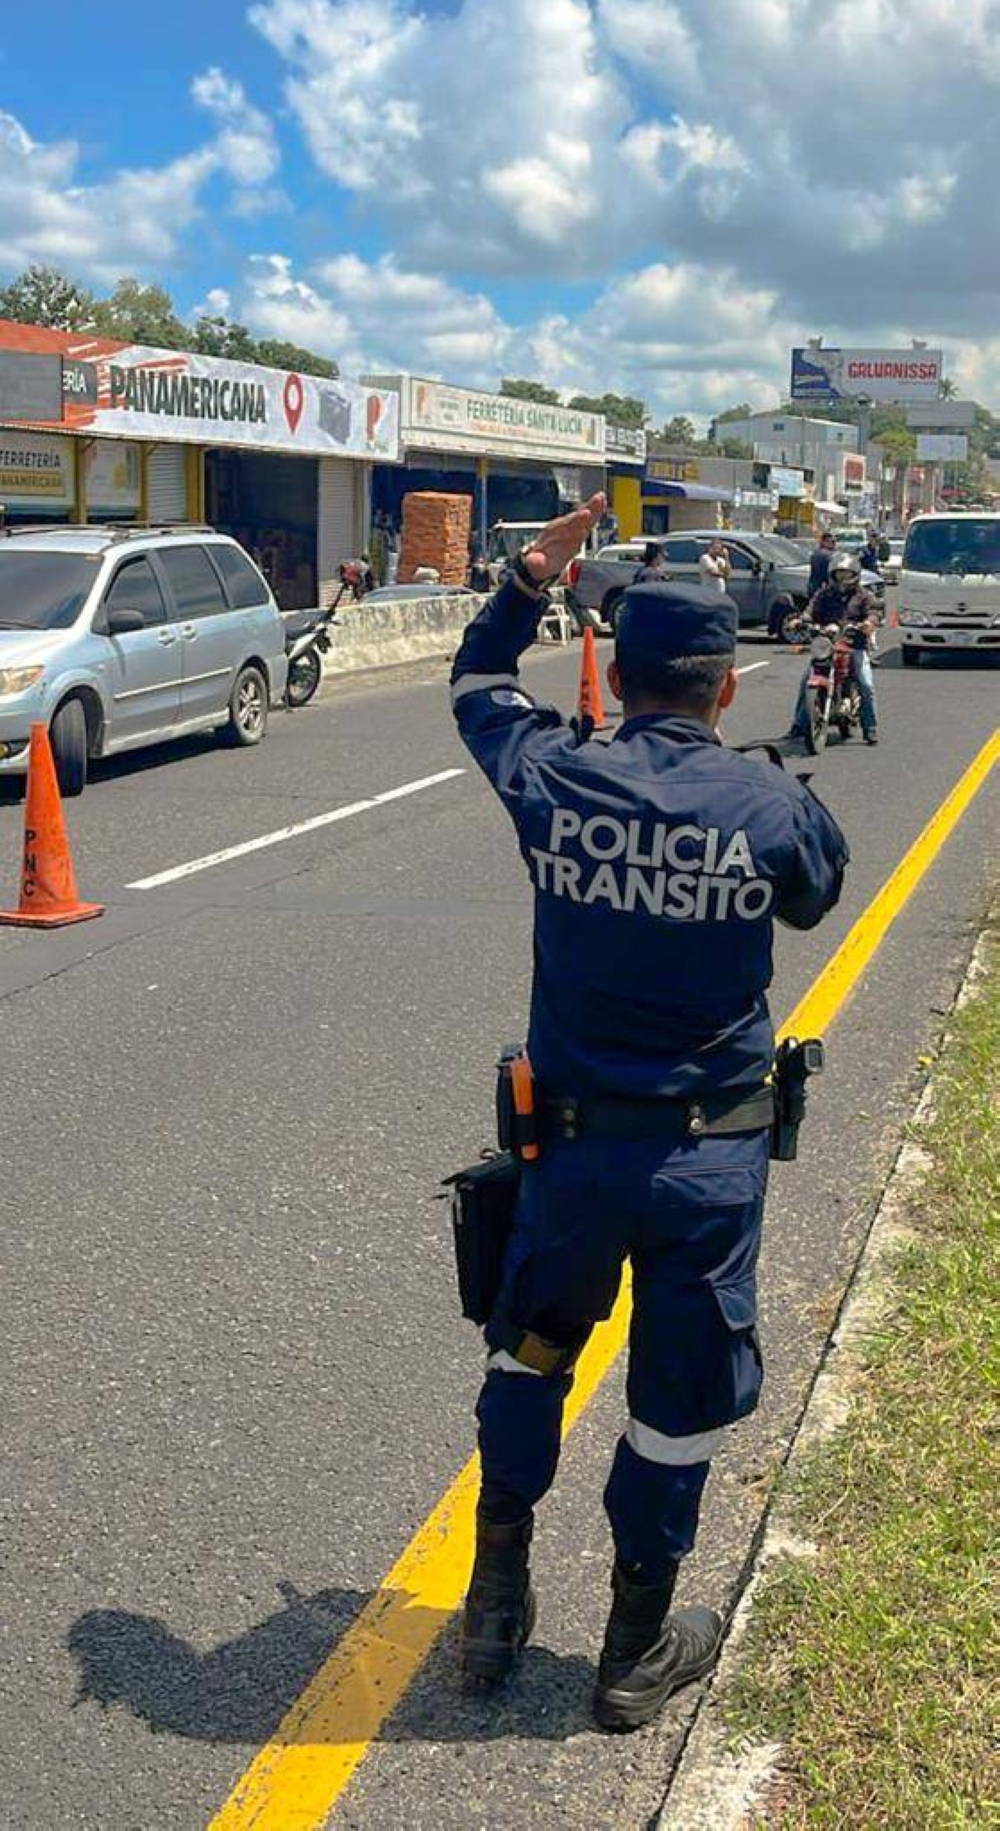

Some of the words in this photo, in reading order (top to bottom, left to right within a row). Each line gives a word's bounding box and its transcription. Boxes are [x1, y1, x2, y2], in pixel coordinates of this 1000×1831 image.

[110, 364, 267, 424] PANAMERICANA
[23, 829, 37, 897] PNC
[549, 807, 757, 878] POLICIA
[529, 846, 774, 922] TRANSITO
